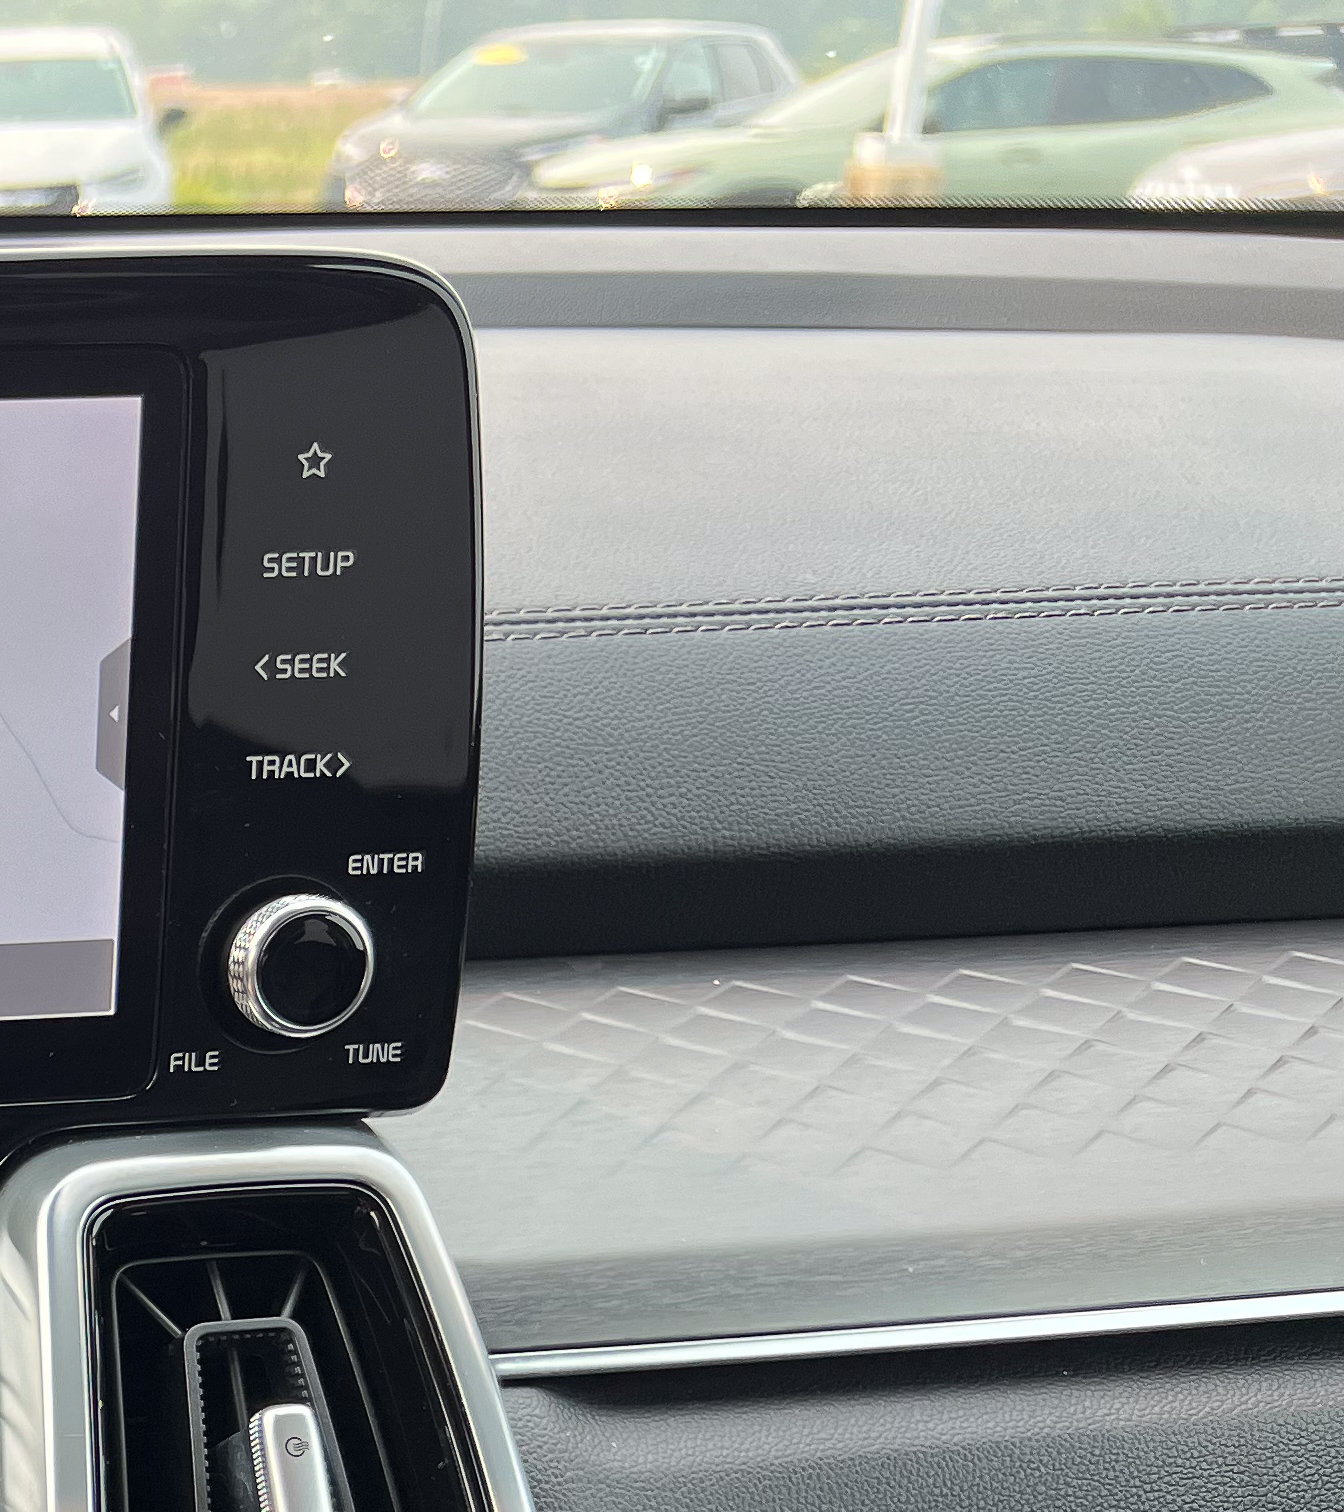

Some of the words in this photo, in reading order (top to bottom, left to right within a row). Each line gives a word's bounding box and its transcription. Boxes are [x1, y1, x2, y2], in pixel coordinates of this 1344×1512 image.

[262, 551, 355, 578] SETUP
[347, 852, 424, 876] ENTER
[169, 1050, 220, 1073] FILE
[344, 1041, 403, 1064] TUNE
